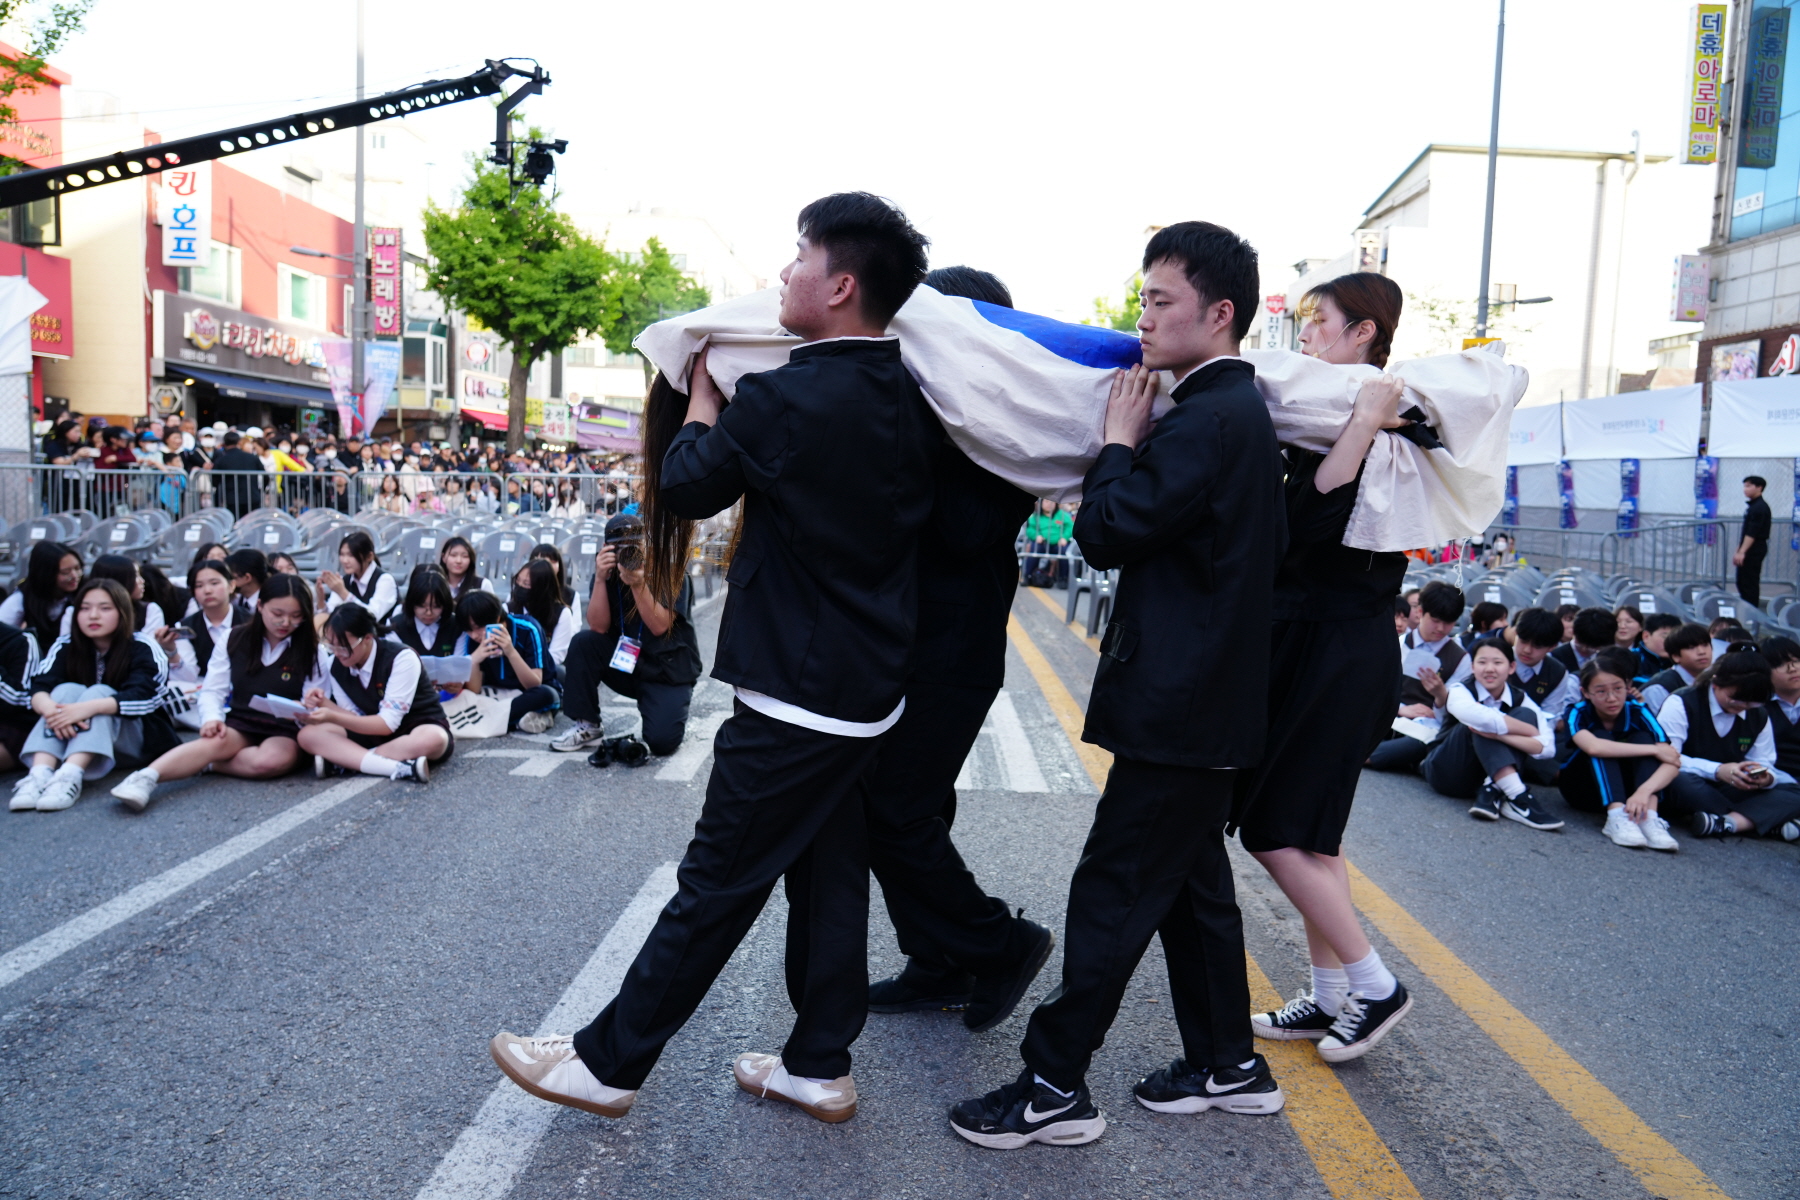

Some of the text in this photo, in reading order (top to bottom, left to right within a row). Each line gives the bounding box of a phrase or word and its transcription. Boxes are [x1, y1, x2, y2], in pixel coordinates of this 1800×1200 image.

[1692, 145, 1713, 156] 2F
[169, 204, 197, 260] 호프
[375, 252, 396, 329] 노래방
